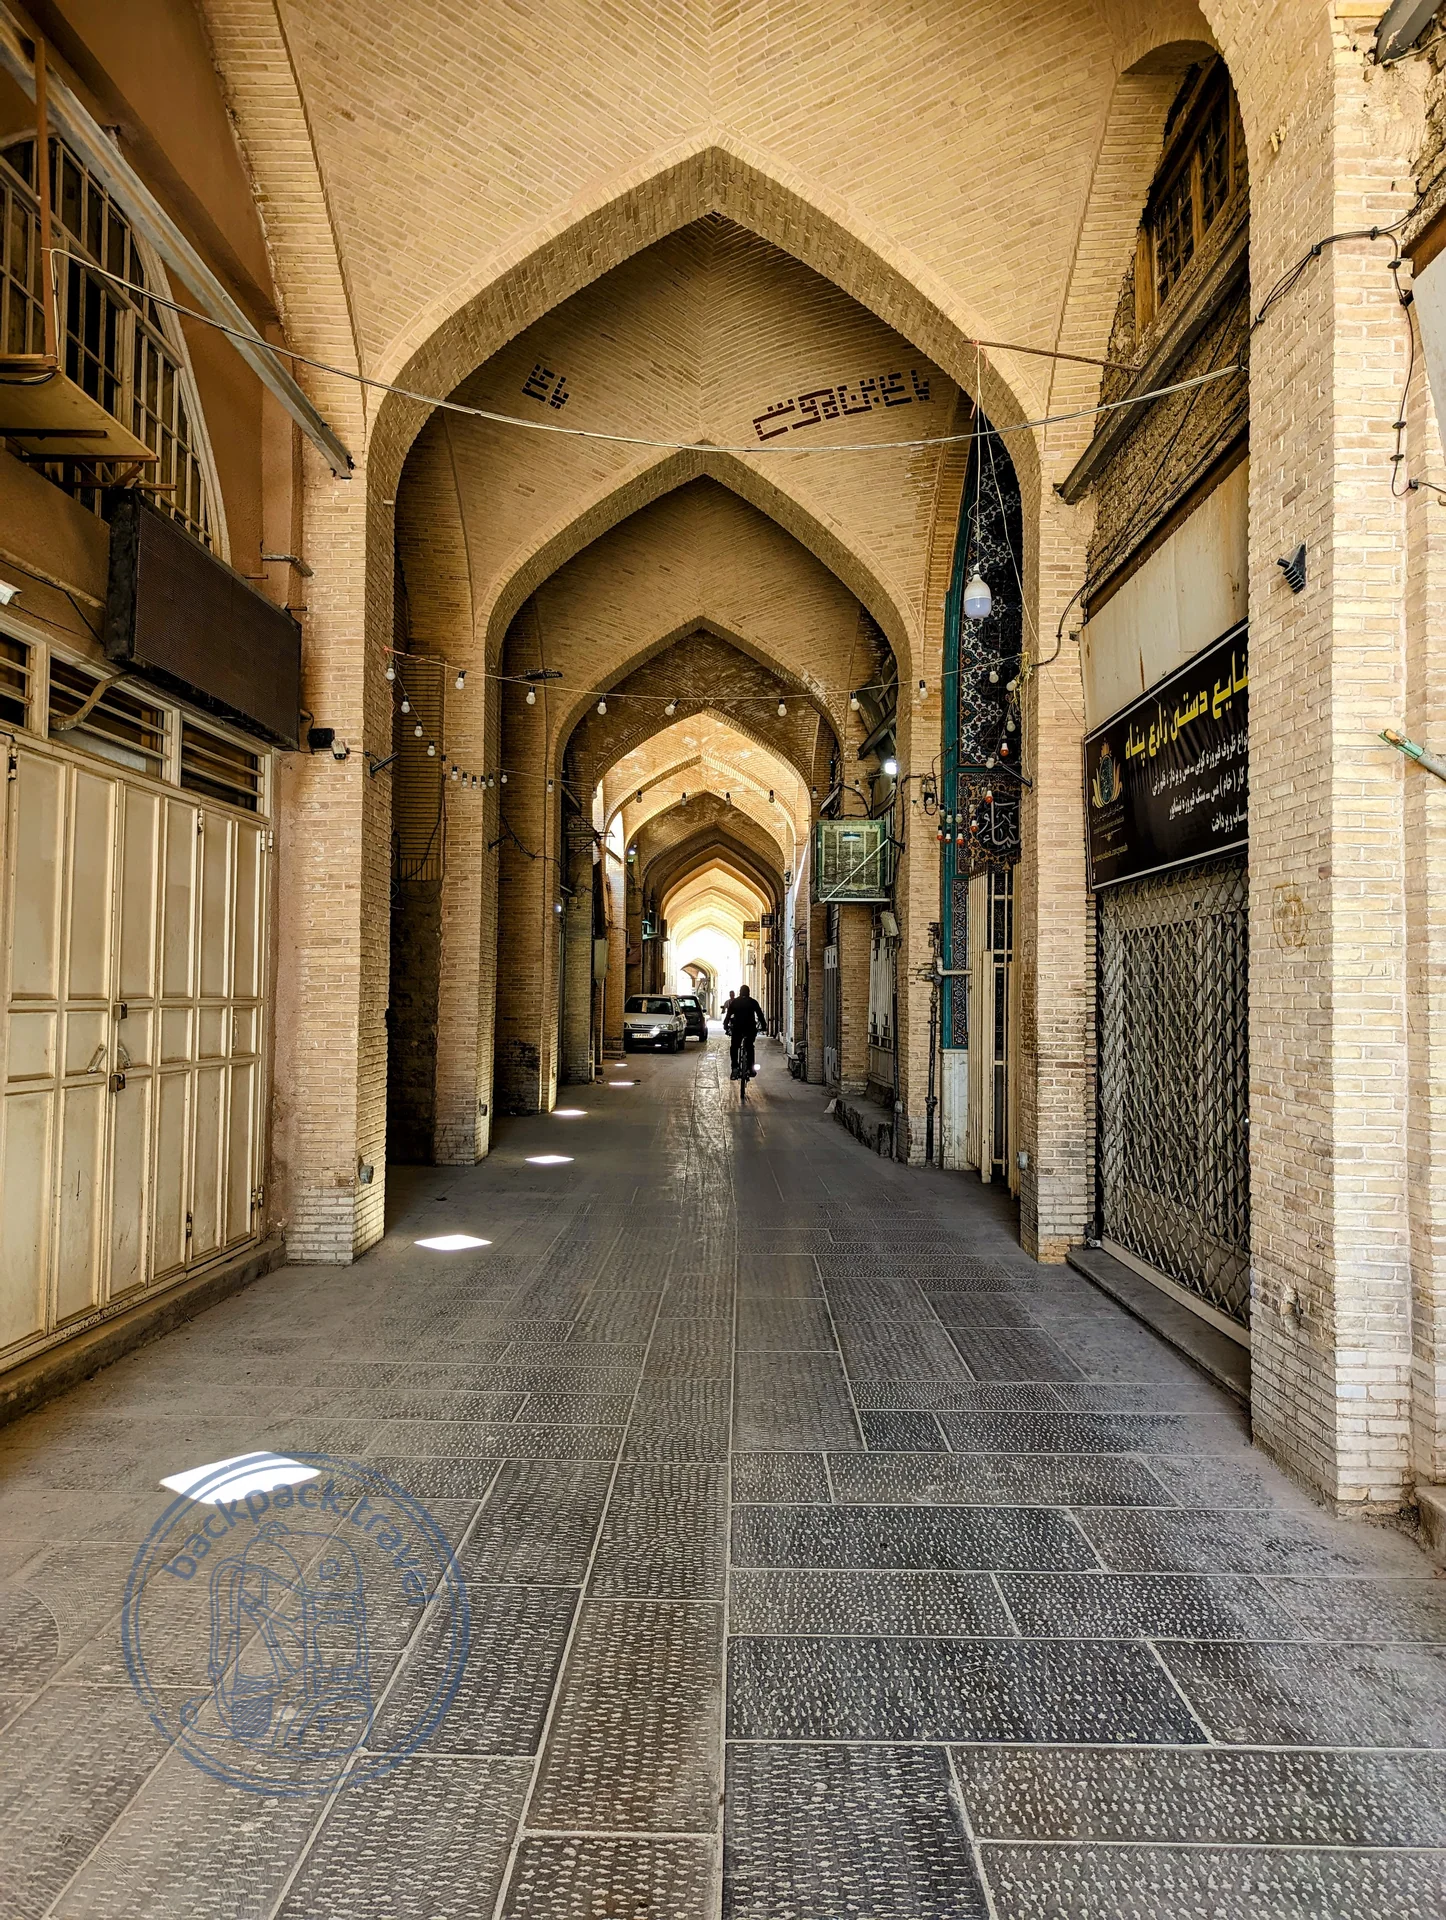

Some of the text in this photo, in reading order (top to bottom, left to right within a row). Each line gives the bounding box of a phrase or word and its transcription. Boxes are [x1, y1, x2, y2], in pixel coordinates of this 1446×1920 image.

[1125, 650, 1249, 767] نایع دستی زارع پناه
[1206, 740, 1221, 769] فیروزه
[1221, 734, 1237, 761] ظروف
